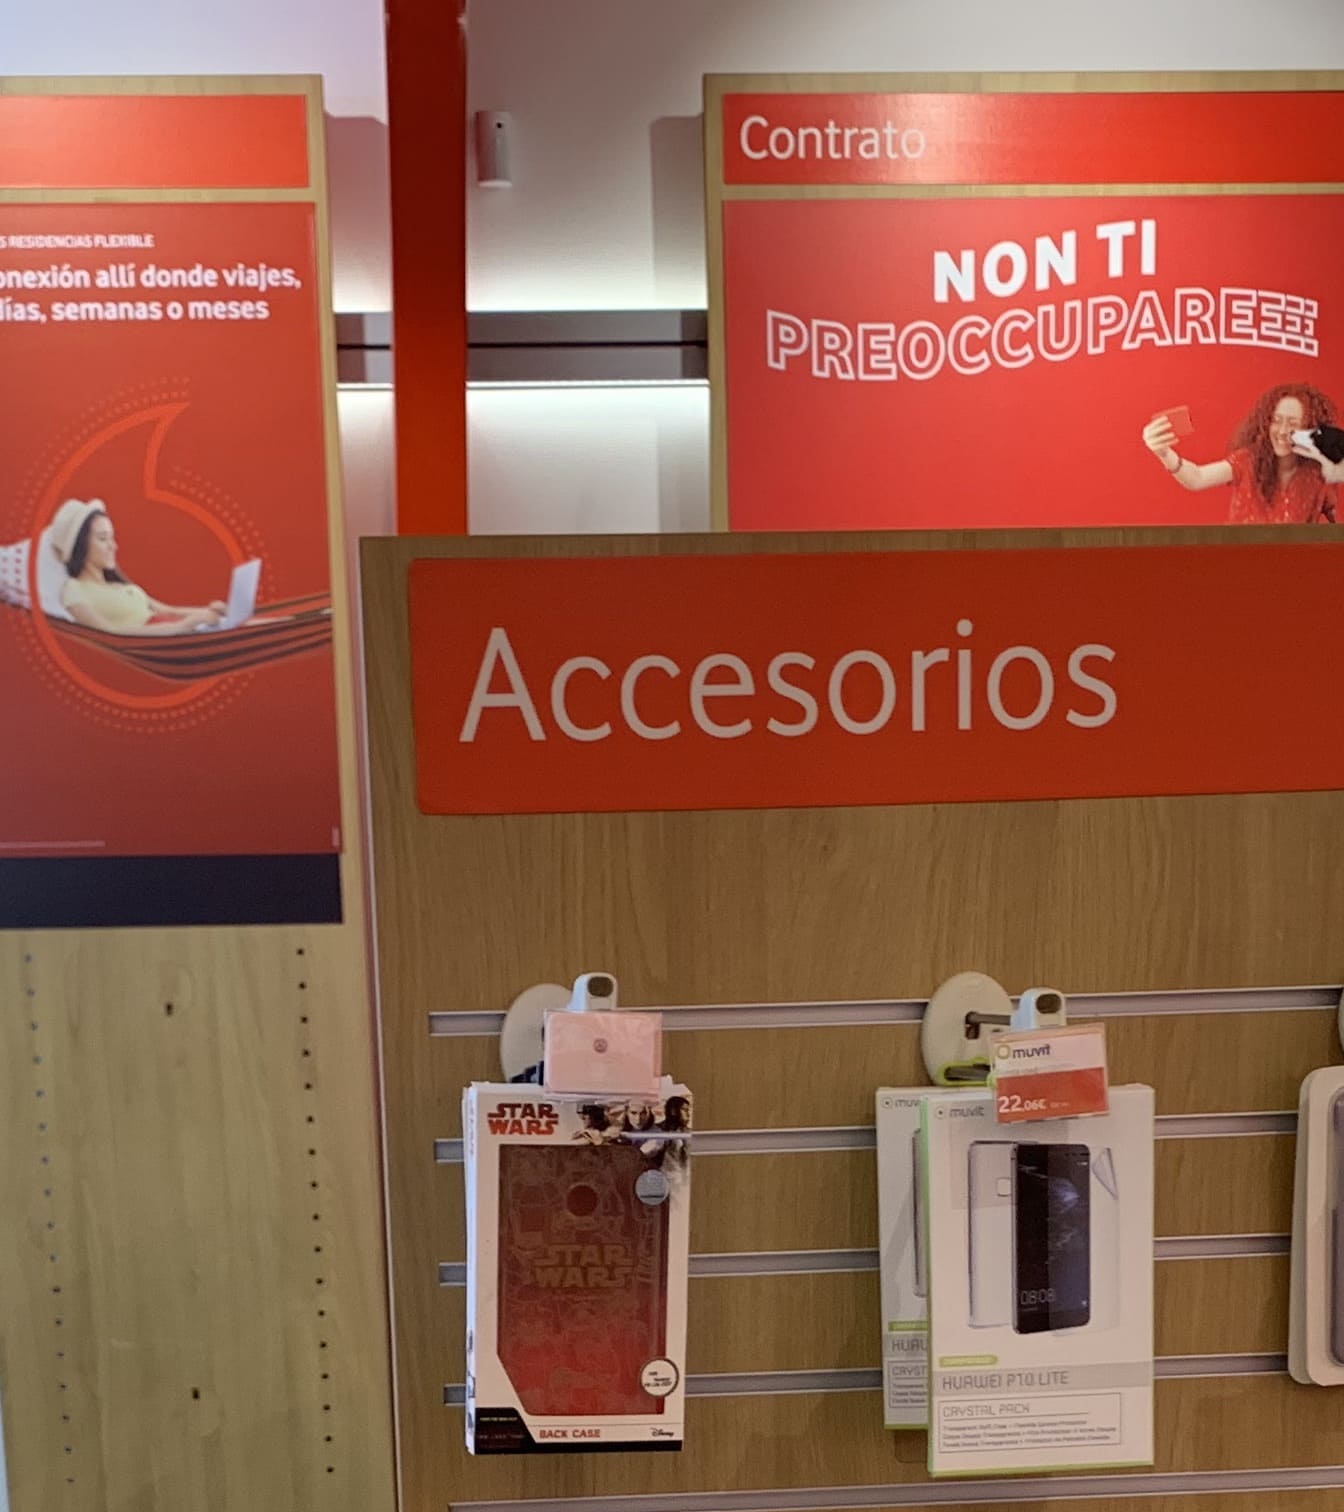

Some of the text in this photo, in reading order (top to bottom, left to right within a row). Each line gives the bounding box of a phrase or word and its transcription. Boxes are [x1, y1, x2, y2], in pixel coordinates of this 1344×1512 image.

[738, 114, 927, 163] Contrato
[9, 234, 92, 249] RESIDENCIAS
[94, 233, 155, 248] FLEXIBLE
[933, 219, 1157, 305] NON TI
[95, 264, 135, 289] allí
[140, 263, 218, 289] donde
[223, 262, 301, 292] viajes,
[51, 300, 163, 321] semanas
[167, 301, 183, 320] o
[188, 299, 270, 320] meses
[459, 618, 1119, 743] Accesorios
[1012, 1044, 1051, 1059] muvit
[487, 1103, 559, 1119] STAR
[895, 1099, 921, 1107] muv
[949, 1106, 985, 1117] muvit
[487, 1120, 558, 1135] WARS
[892, 1366, 928, 1376] CRYST
[942, 1371, 1069, 1391] HUAWEI P10 LITE
[943, 1403, 1030, 1418] CRYSTAL PACK
[539, 1429, 601, 1439] BACK CASE
